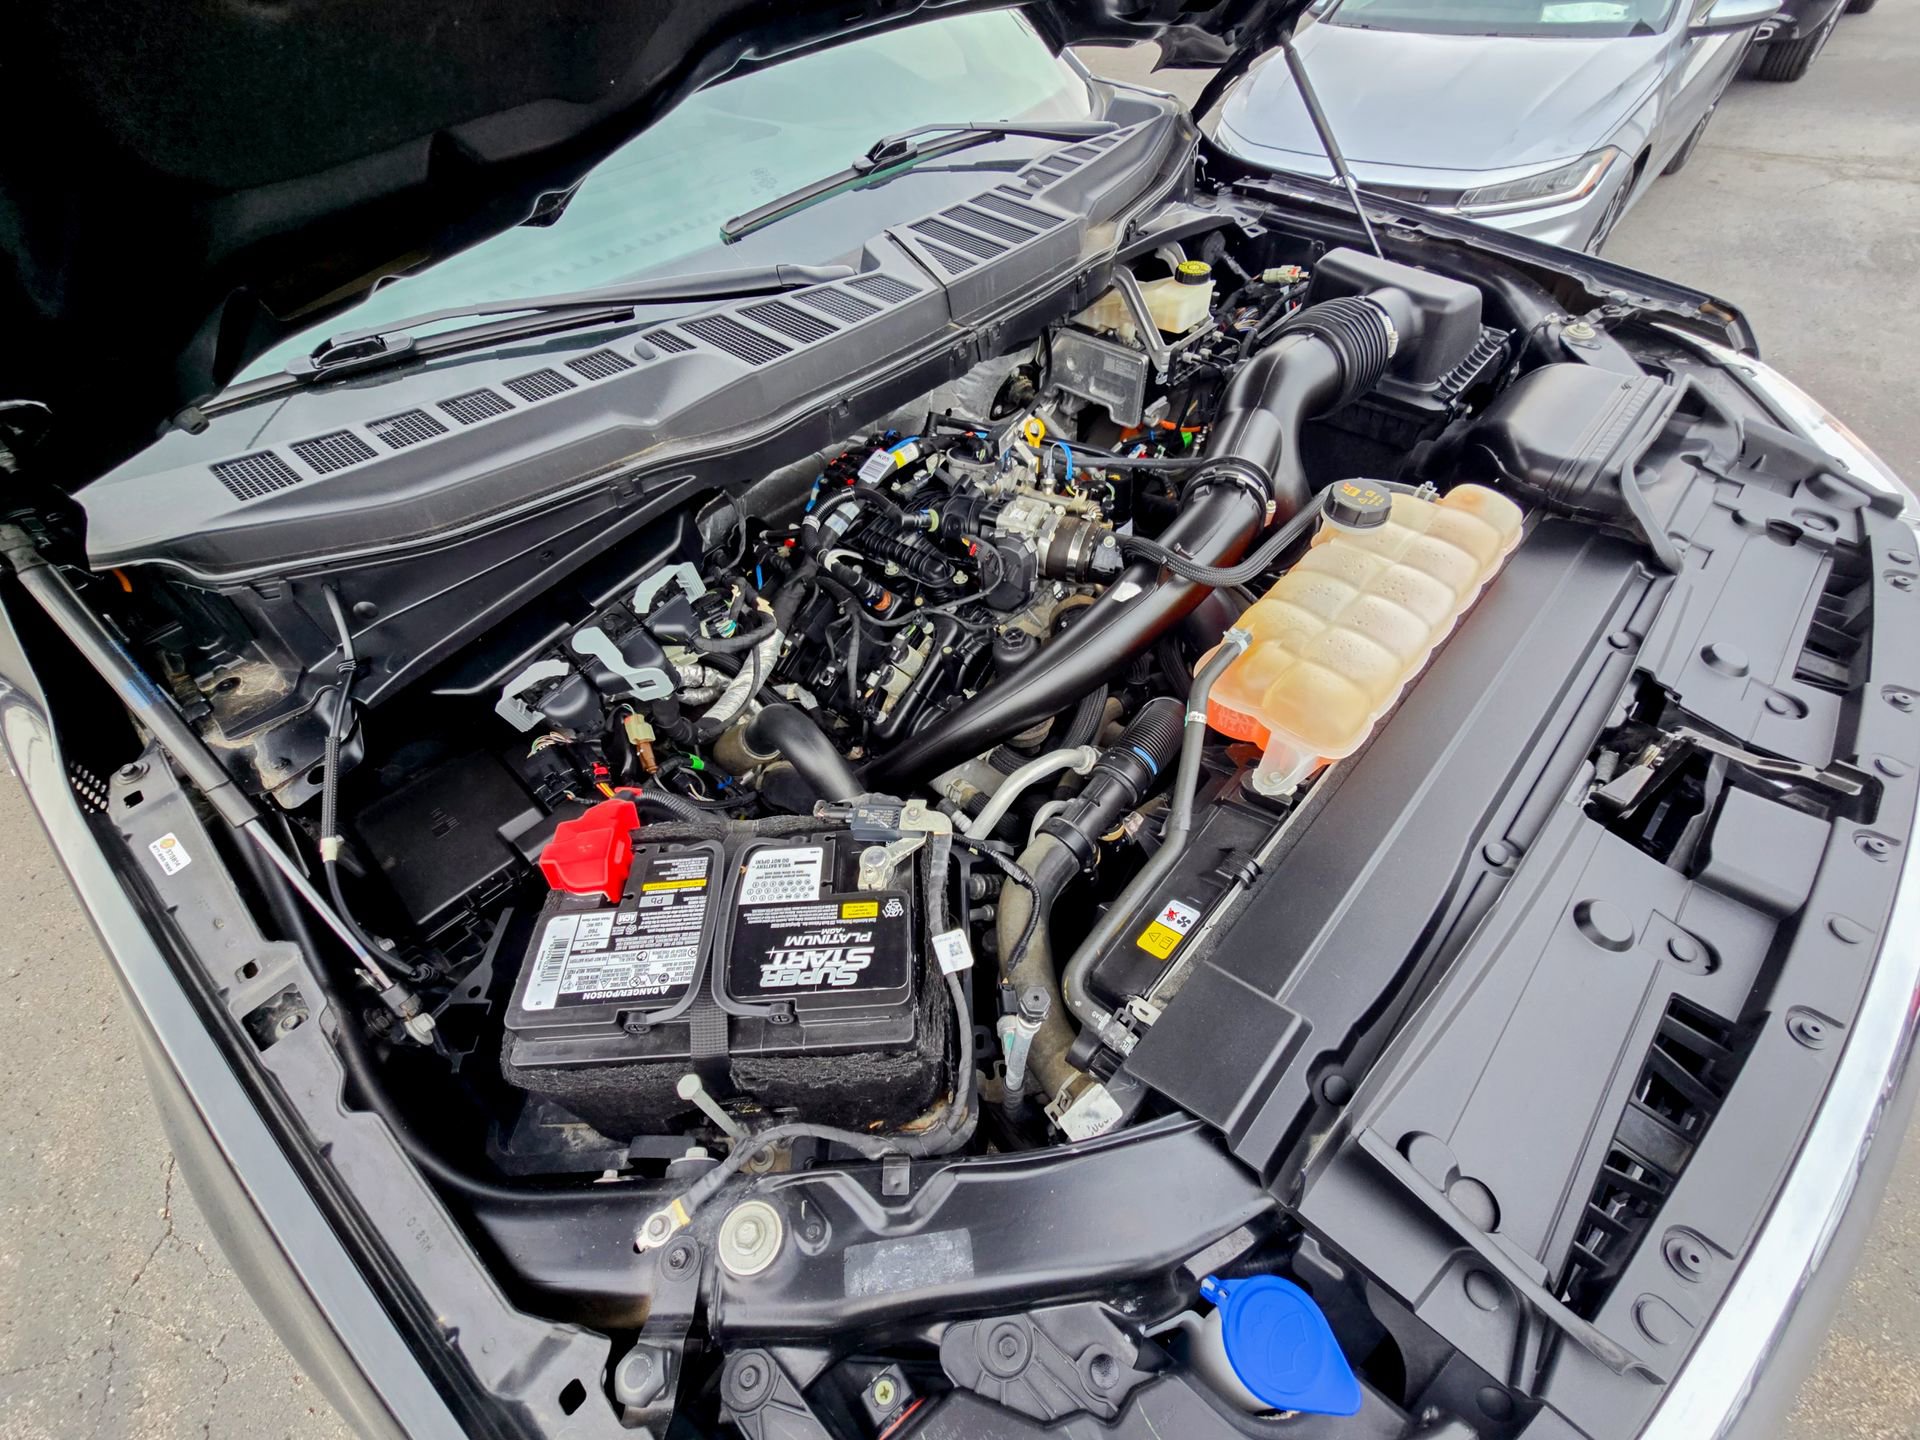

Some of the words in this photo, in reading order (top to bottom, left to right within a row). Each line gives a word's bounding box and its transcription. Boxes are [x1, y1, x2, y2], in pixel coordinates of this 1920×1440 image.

[784, 931, 872, 946] PLATINUM
[761, 946, 874, 970] START
[760, 966, 858, 987] SUPER
[583, 987, 659, 1000] DANGER/POISON
